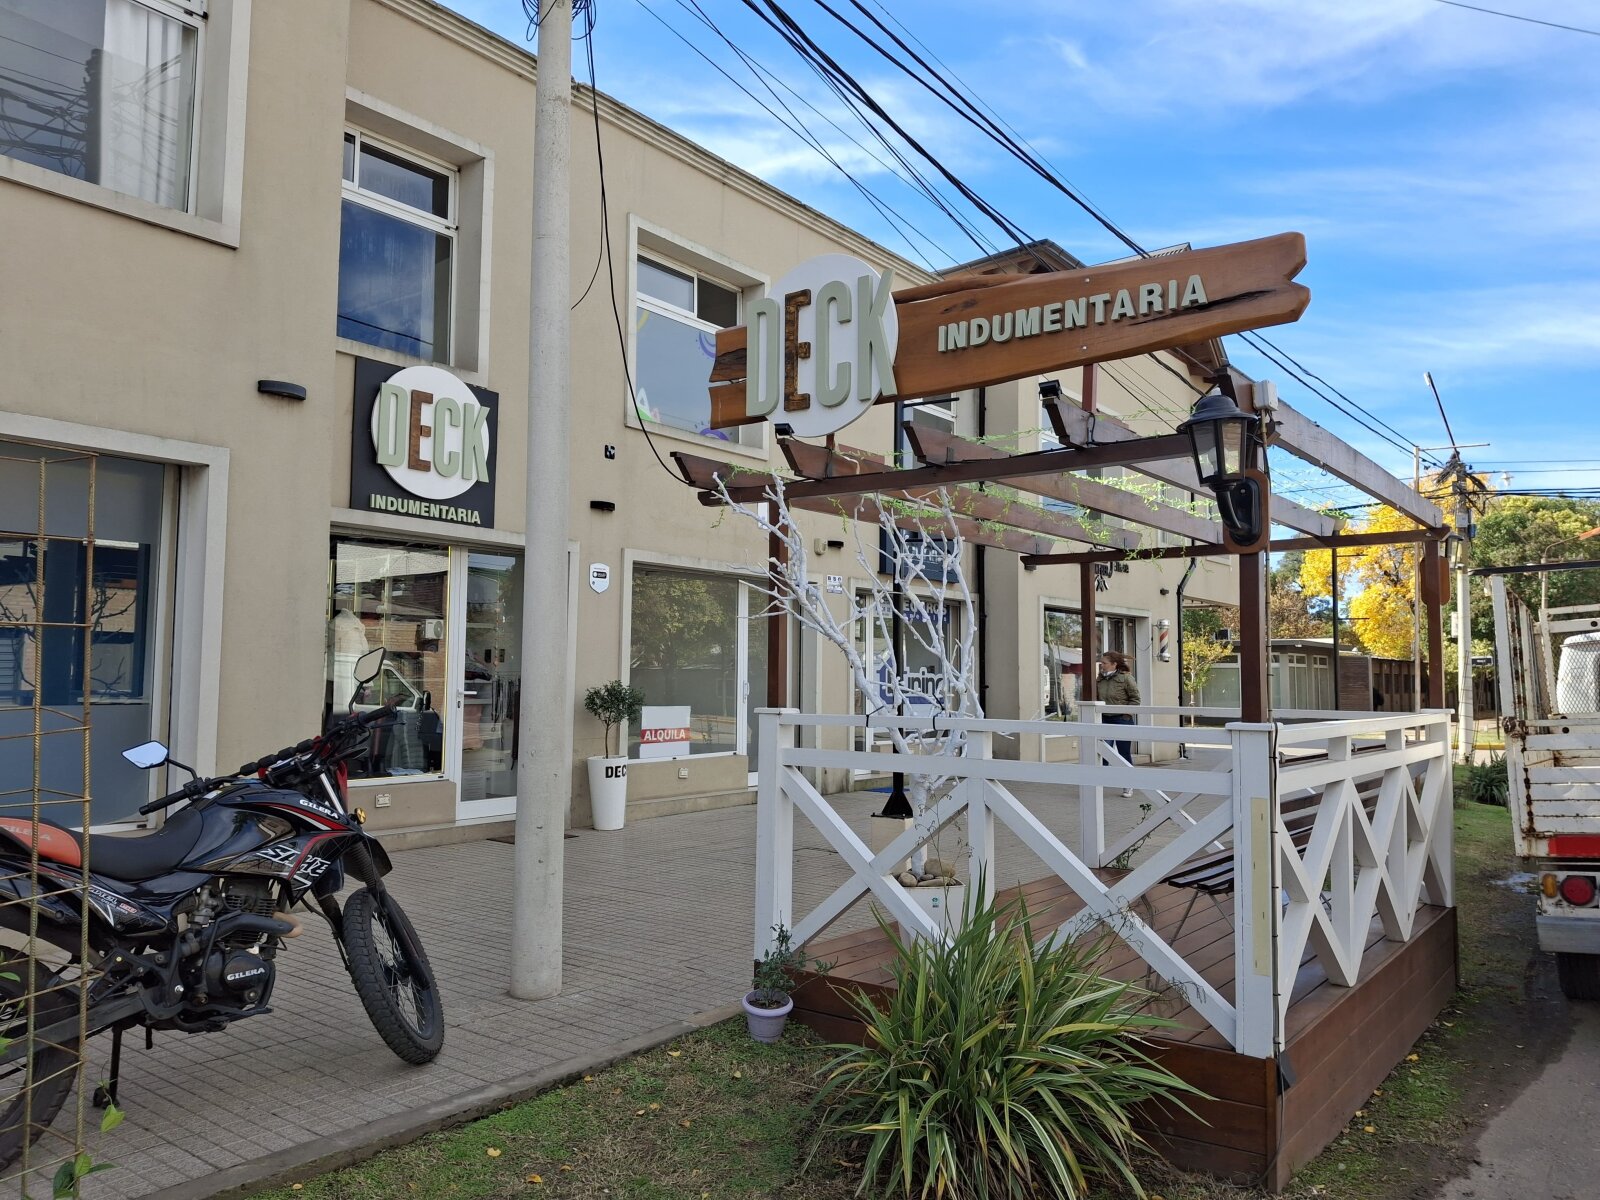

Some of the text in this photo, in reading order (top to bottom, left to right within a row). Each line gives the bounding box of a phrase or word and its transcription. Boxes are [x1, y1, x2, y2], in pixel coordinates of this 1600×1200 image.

[937, 273, 1208, 353] INDUMENTARIA
[745, 268, 898, 421] DECK
[376, 382, 490, 484] DECK
[371, 494, 481, 524] INDUMENTARIA
[643, 729, 686, 742] ALQUILA
[299, 799, 339, 819] GILERA
[227, 967, 265, 981] GILERA
